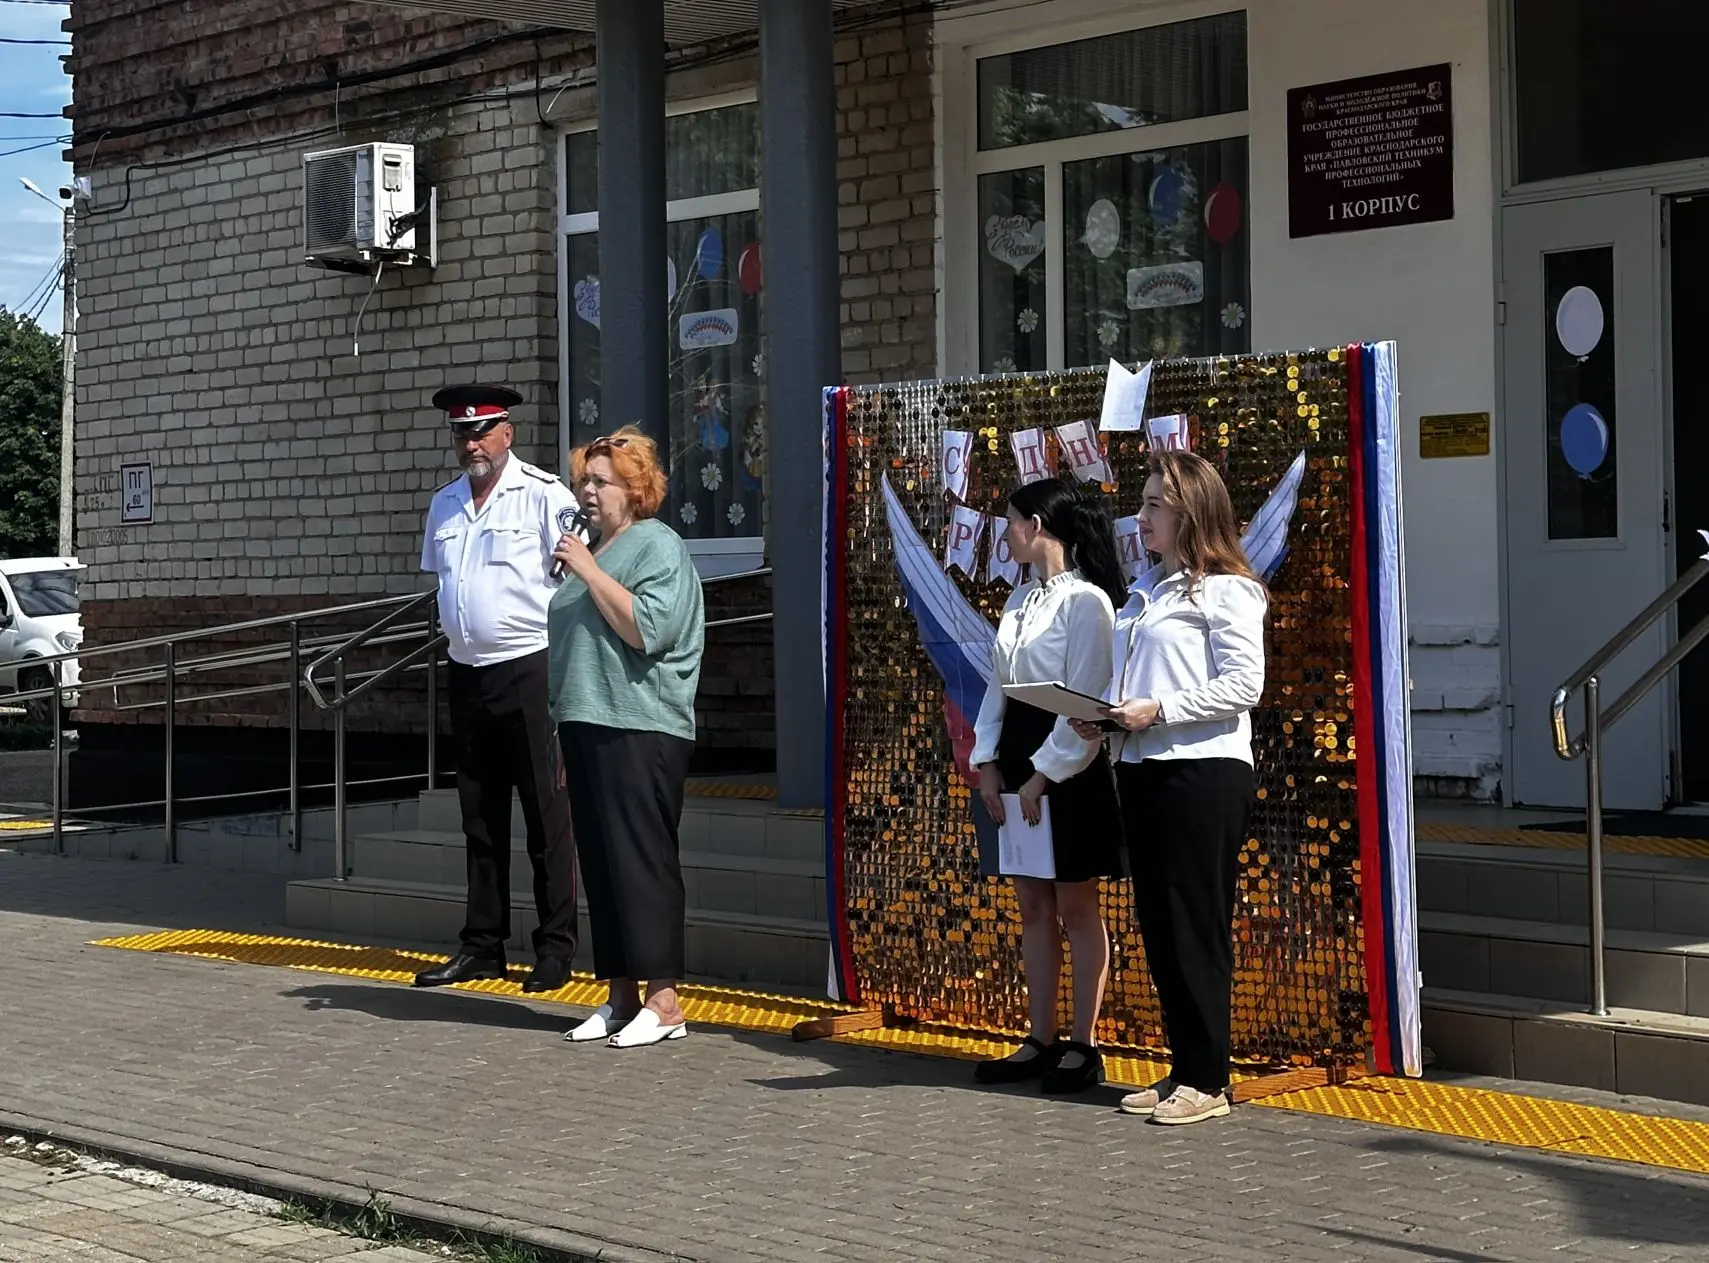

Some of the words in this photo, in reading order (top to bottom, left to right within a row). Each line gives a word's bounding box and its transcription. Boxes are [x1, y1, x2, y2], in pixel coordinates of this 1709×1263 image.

[1302, 112, 1384, 132] ГОСУДАРСТВЕННОЕ
[1386, 104, 1444, 120] БЮДЖЕТНОЕ
[1325, 117, 1419, 139] ПРОФЕССИОНАЛЬНОЕ
[1303, 147, 1362, 163] УЧРЕЖДЕНИЕ
[1364, 135, 1445, 154] КРАСНОДАРСКОГО
[1331, 129, 1414, 149] ОБРАЗОВАТЕЛЬНОЕ
[1304, 161, 1327, 173] КРАЯ
[1394, 146, 1444, 160] ТЕХНИКУМ
[1325, 159, 1422, 180] ПРОФЕССИОНАЛЬНЫХ
[1328, 204, 1335, 220] 1
[1341, 193, 1421, 219] КОРПУС
[944, 447, 961, 475] С
[128, 470, 144, 489] ПГ
[132, 494, 142, 506] 60
